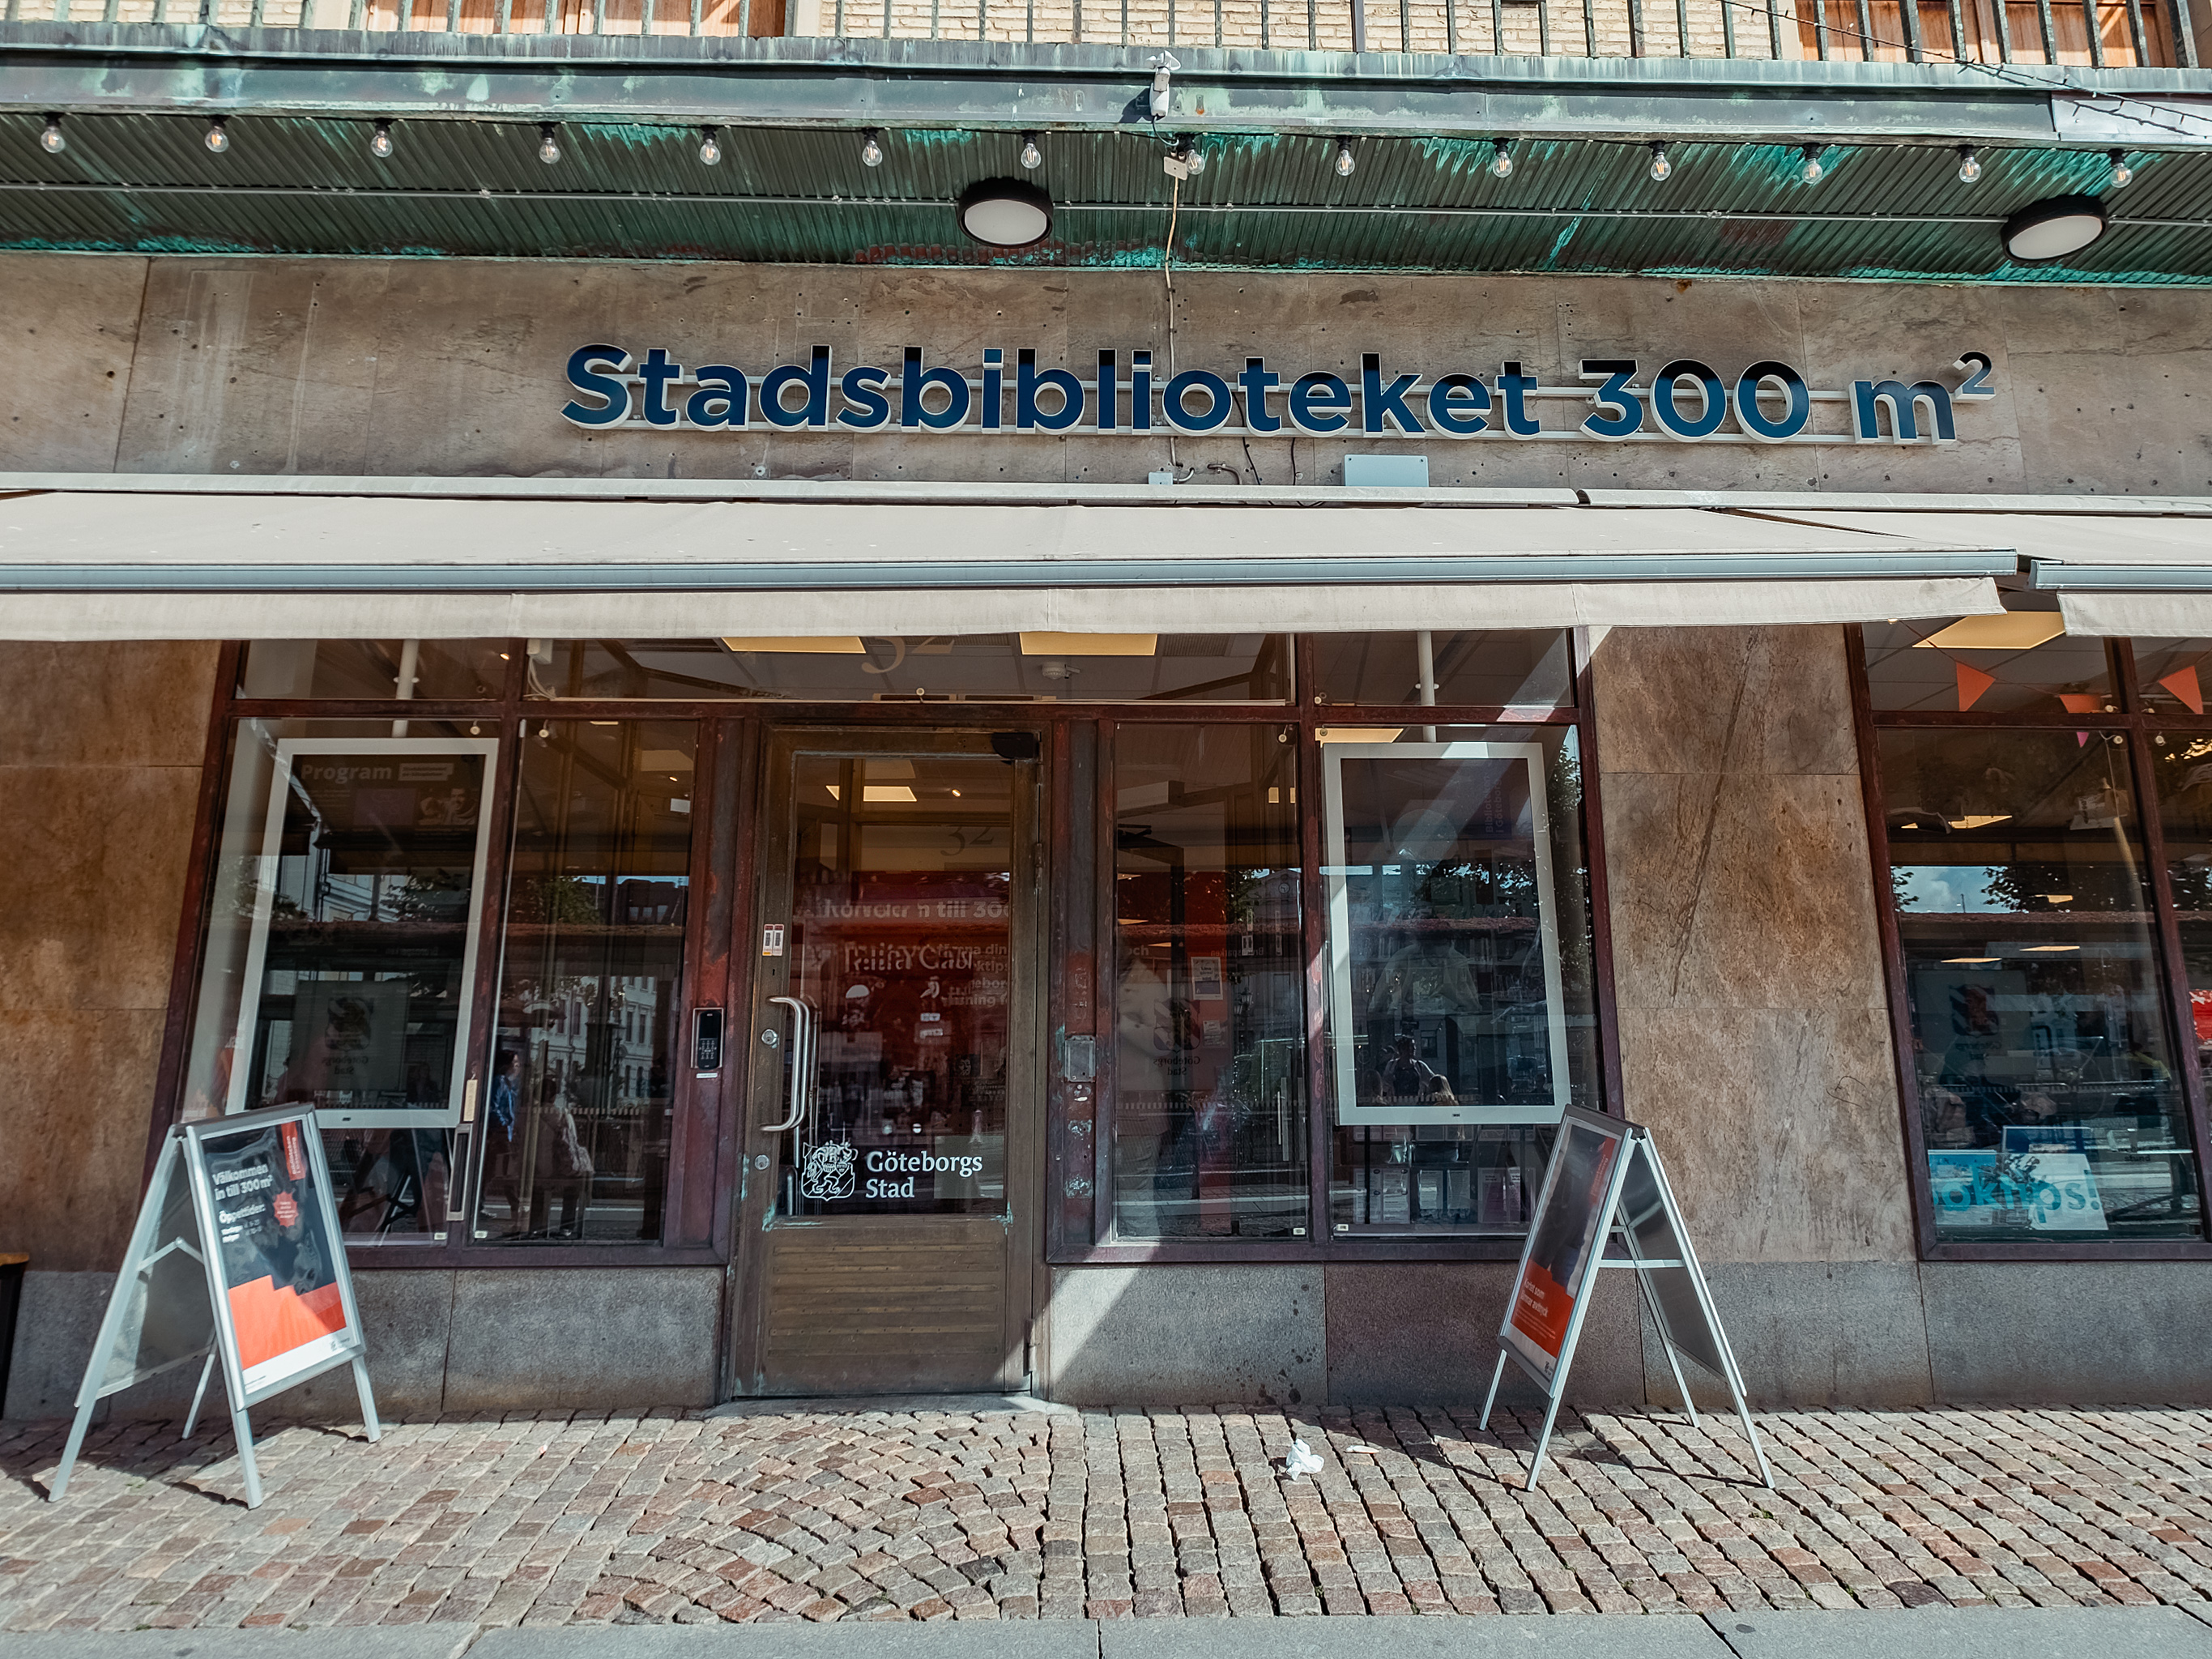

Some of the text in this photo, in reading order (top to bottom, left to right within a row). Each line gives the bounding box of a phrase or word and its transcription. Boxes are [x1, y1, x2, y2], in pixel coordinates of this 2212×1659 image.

[560, 343, 1541, 440] Stadsbiblioteket
[1579, 357, 1812, 443] 300
[300, 763, 392, 783] Program
[937, 901, 966, 918] till
[985, 944, 1007, 955] din
[866, 1150, 982, 1176] Göteborgs
[211, 1163, 270, 1186] Välkommen
[214, 1188, 226, 1201] in
[226, 1183, 241, 1197] till
[240, 1178, 261, 1194] 300
[865, 1177, 915, 1198] Stad
